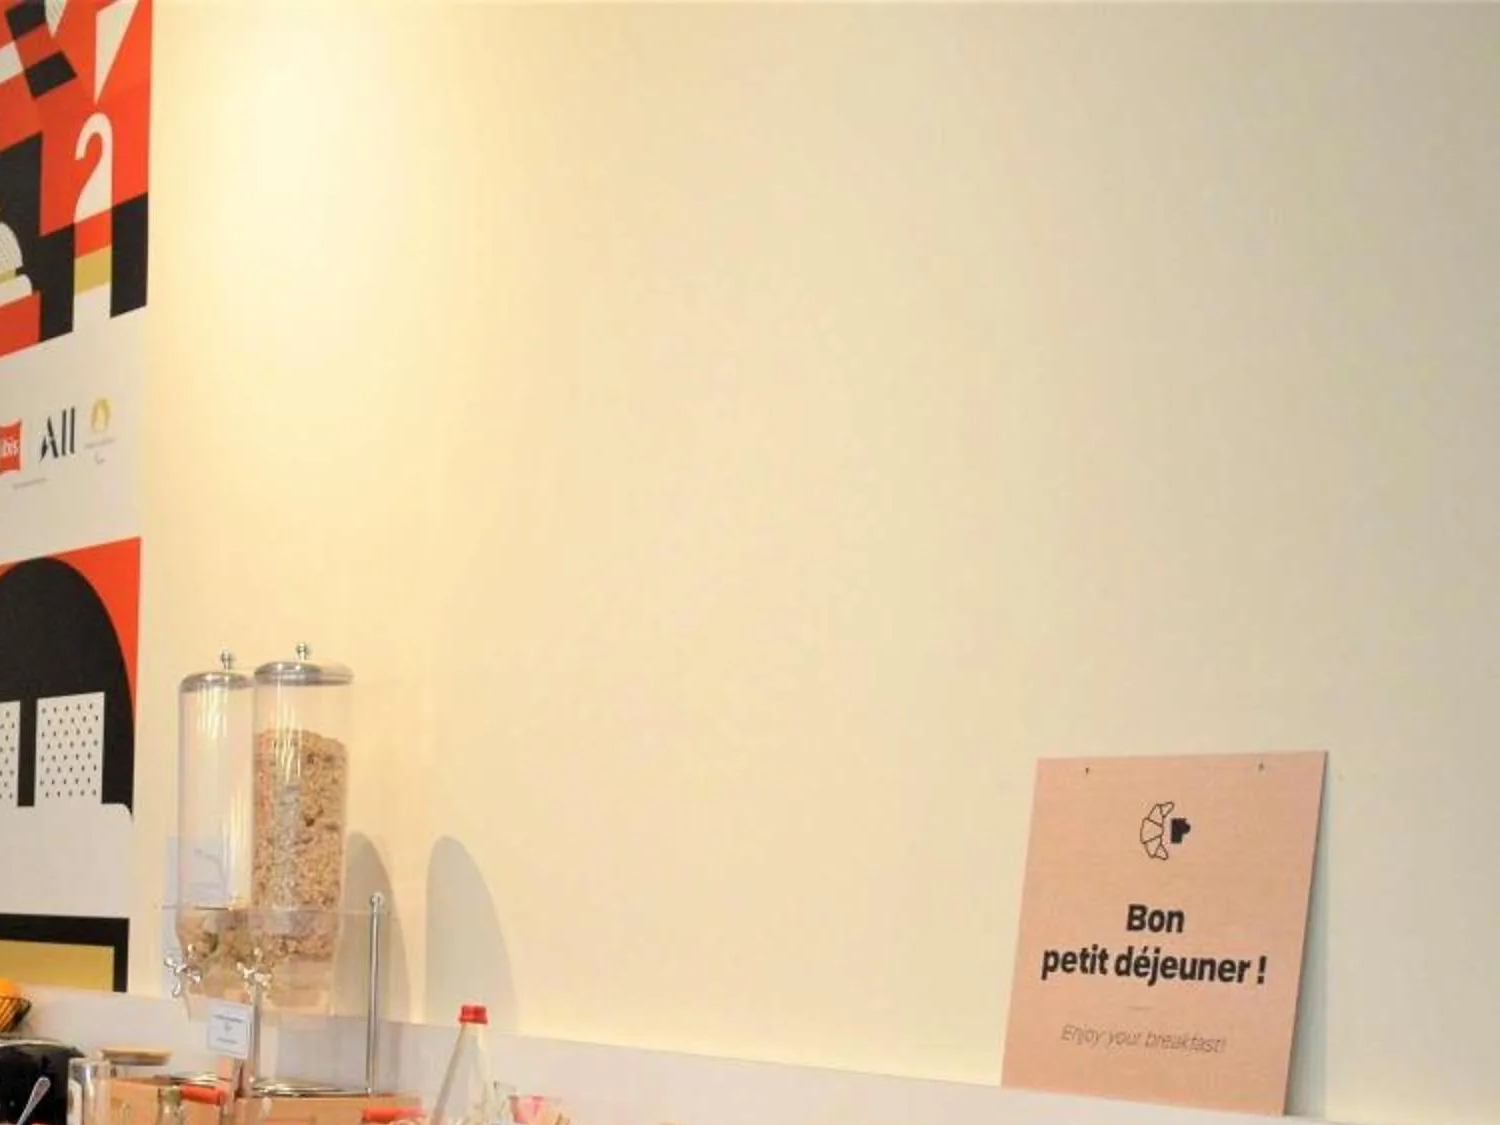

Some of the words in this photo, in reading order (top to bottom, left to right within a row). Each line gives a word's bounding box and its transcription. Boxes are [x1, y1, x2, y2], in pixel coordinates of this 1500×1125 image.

[1126, 904, 1185, 934] Bon
[1041, 944, 1109, 981] petit
[1114, 945, 1251, 987] déjeuner
[1061, 1023, 1105, 1047] Enjoy
[1108, 1031, 1142, 1047] your
